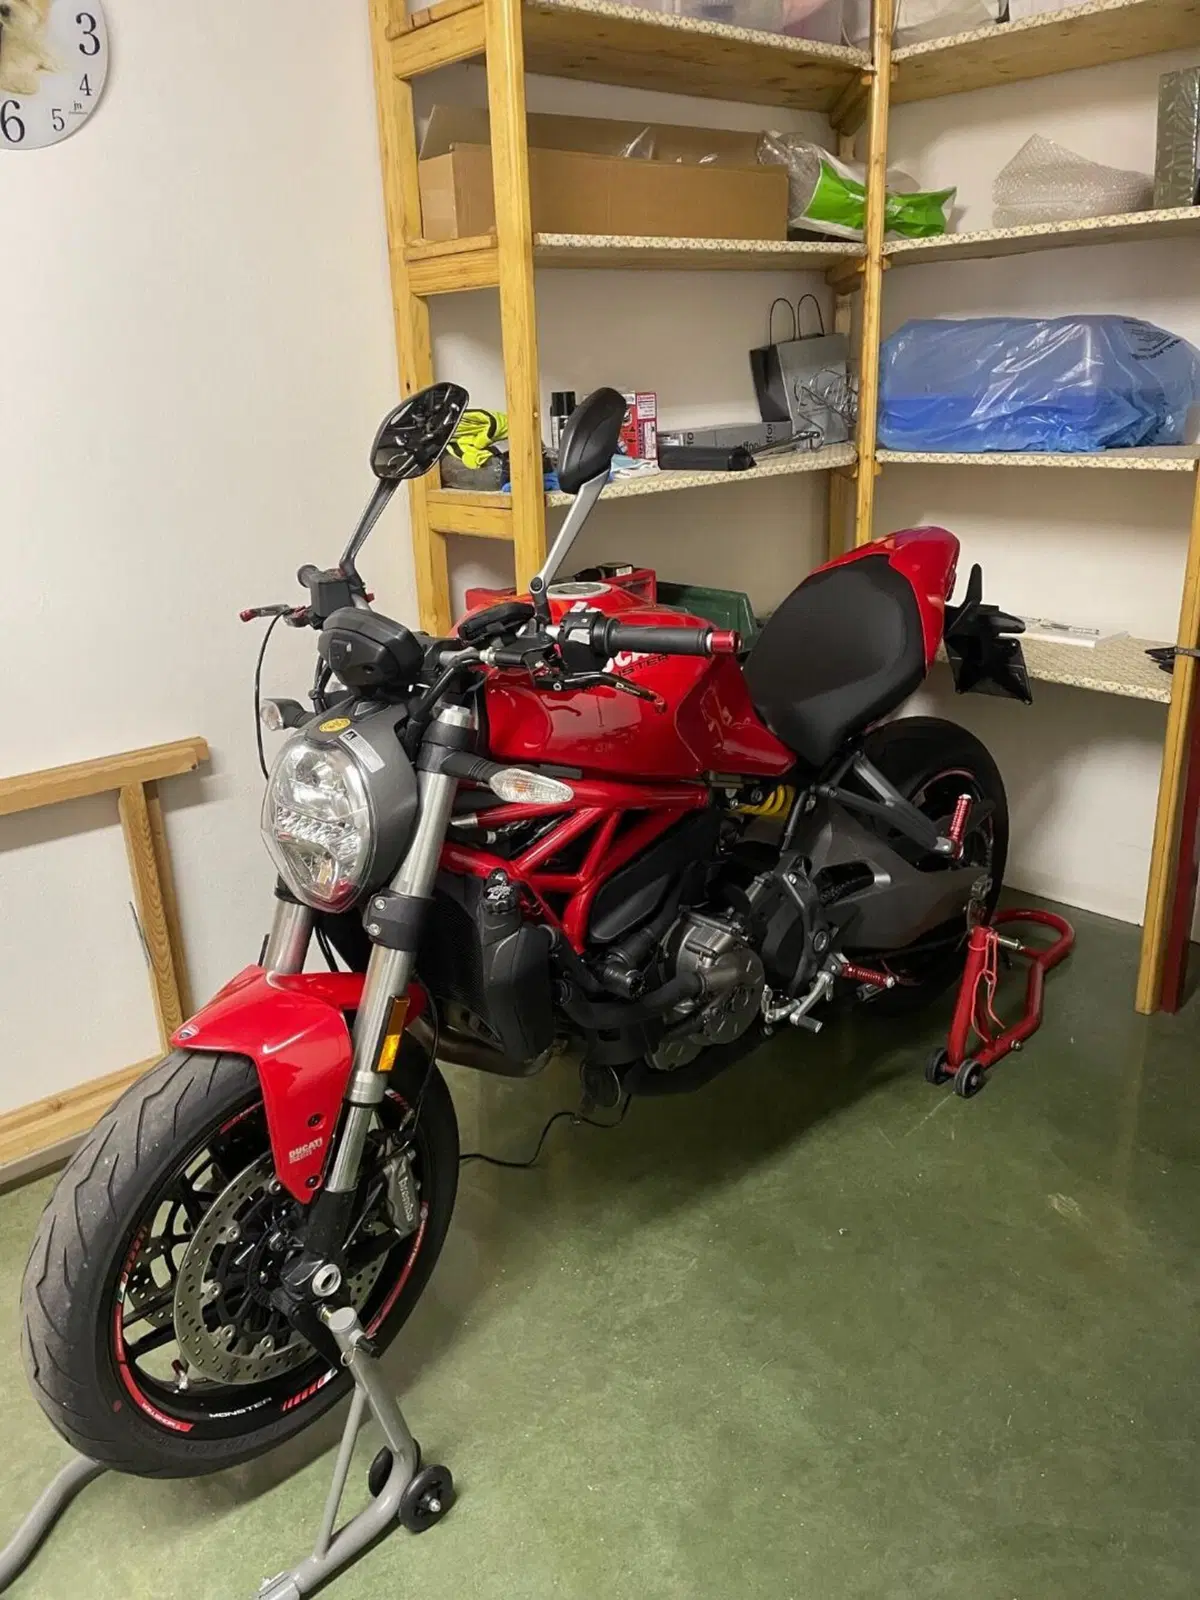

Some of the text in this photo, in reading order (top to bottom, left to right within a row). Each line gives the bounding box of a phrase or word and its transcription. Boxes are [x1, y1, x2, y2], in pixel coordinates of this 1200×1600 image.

[75, 12, 101, 56] 3
[79, 73, 92, 96] 4
[0, 99, 26, 143] 6
[51, 108, 65, 132] 5
[288, 1136, 323, 1158] DUCATI
[398, 1176, 414, 1222] brembo
[208, 1397, 272, 1418] MONSTER
